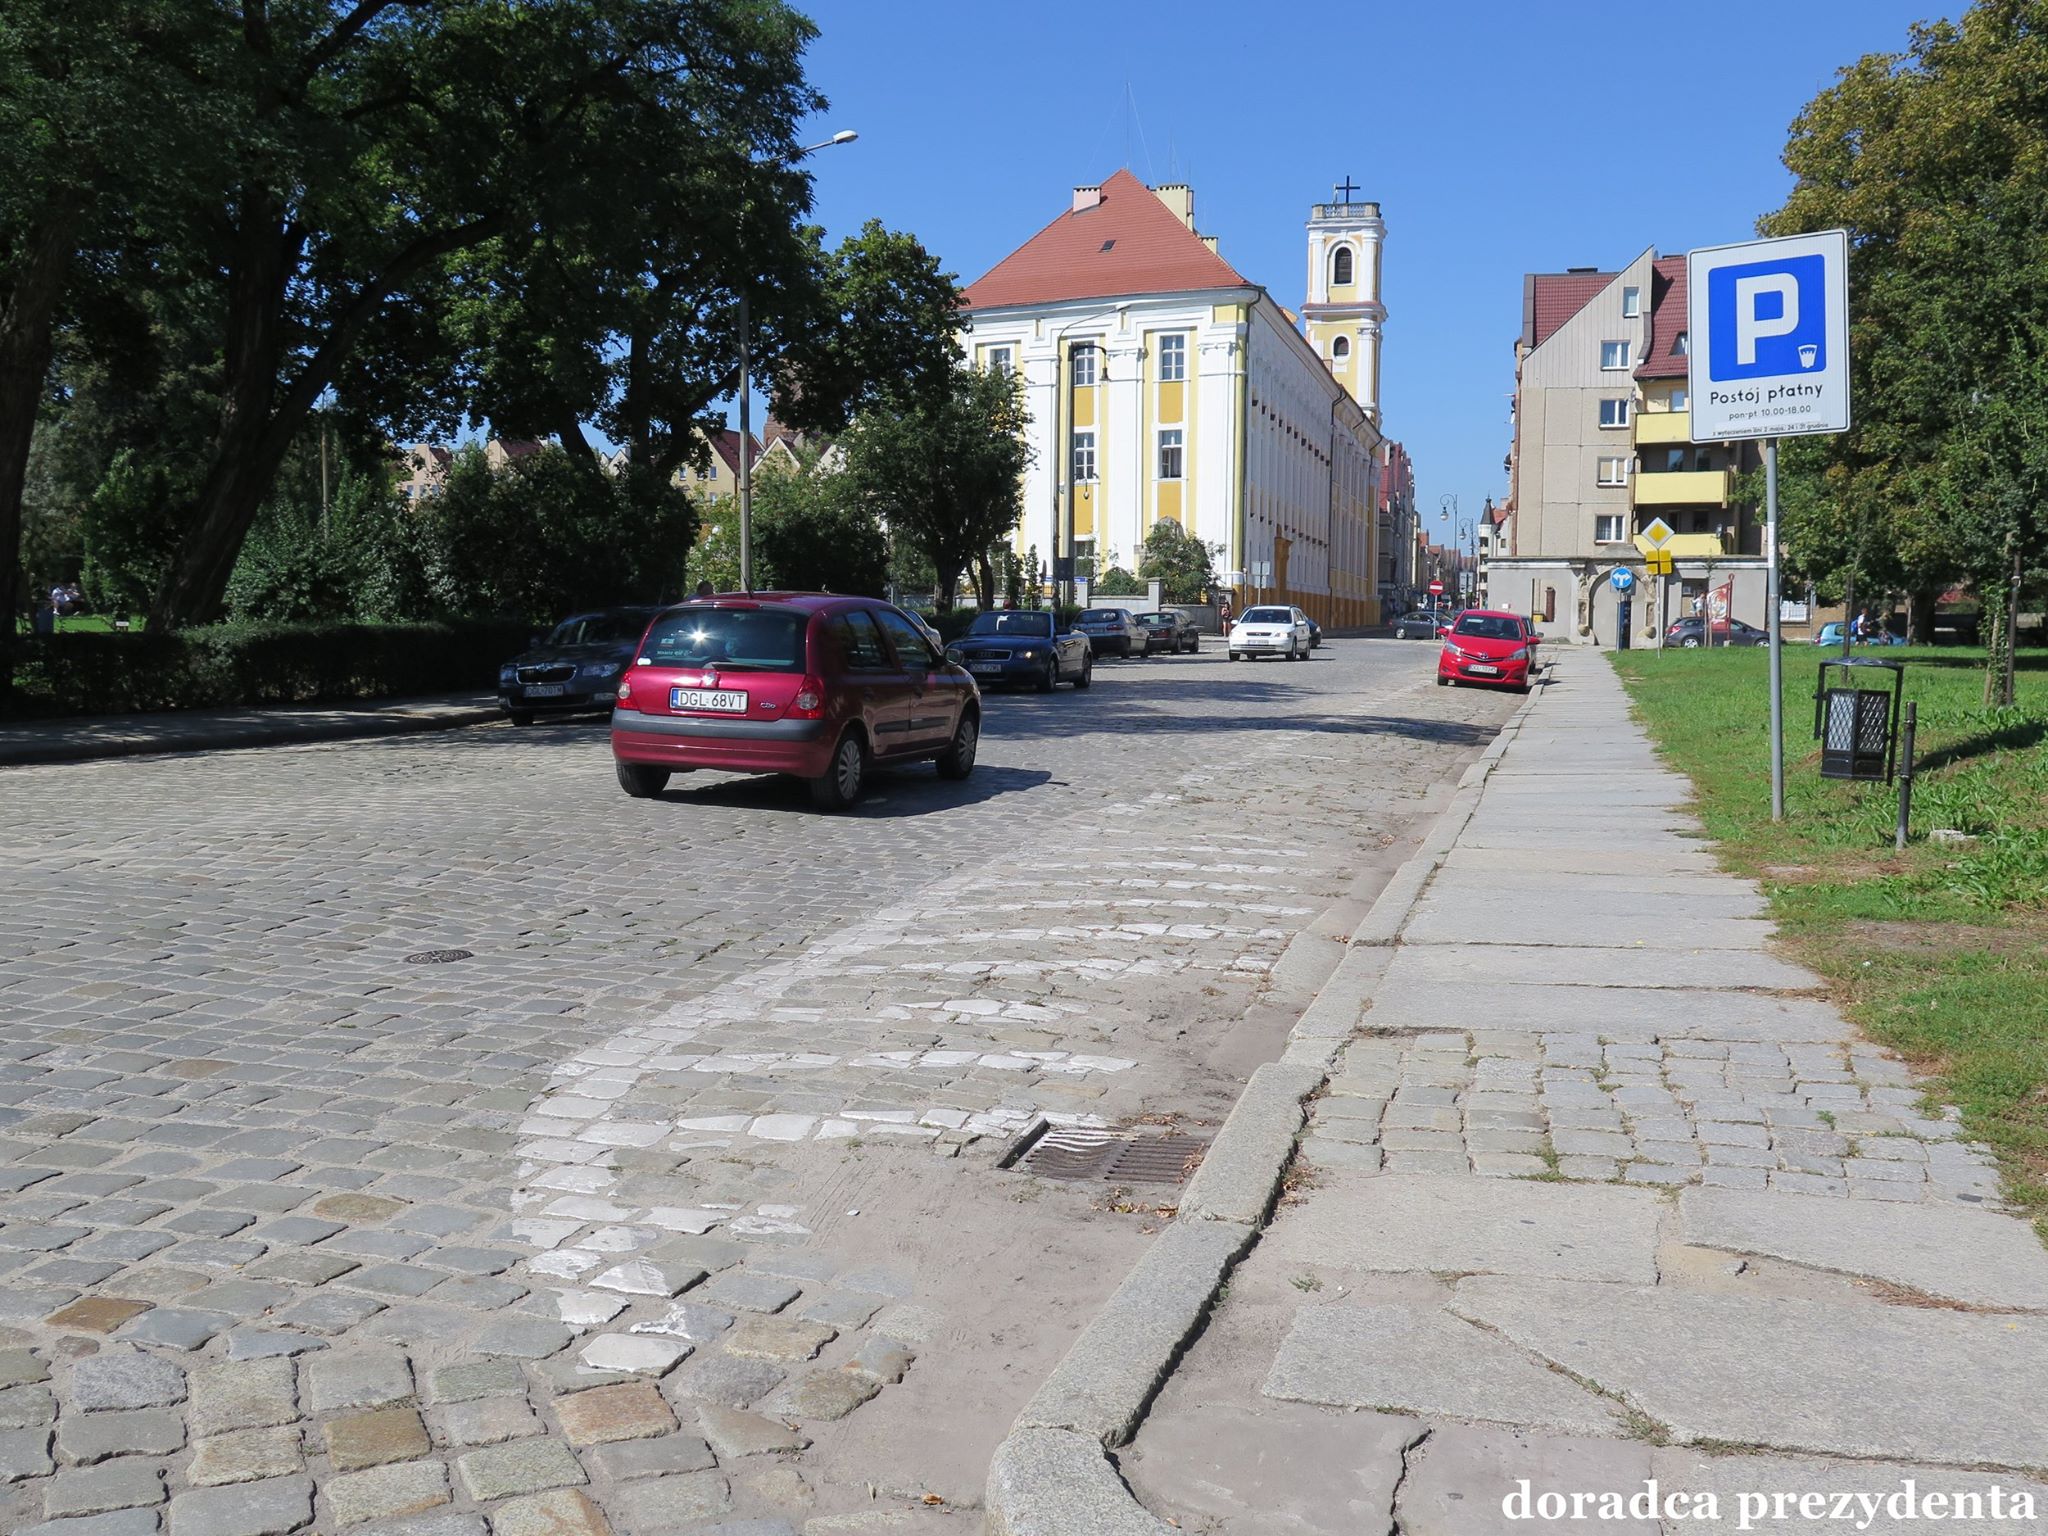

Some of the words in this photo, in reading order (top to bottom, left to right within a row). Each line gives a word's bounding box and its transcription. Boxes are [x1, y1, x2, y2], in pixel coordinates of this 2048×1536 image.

[1736, 272, 1799, 365] P
[1710, 387, 1760, 405] Postój
[1768, 384, 1823, 403] płatny
[1729, 411, 1757, 421] pon-pt
[1761, 405, 1812, 417] 10.00-18.00
[680, 692, 707, 706] DGL
[711, 694, 745, 708] 68VT
